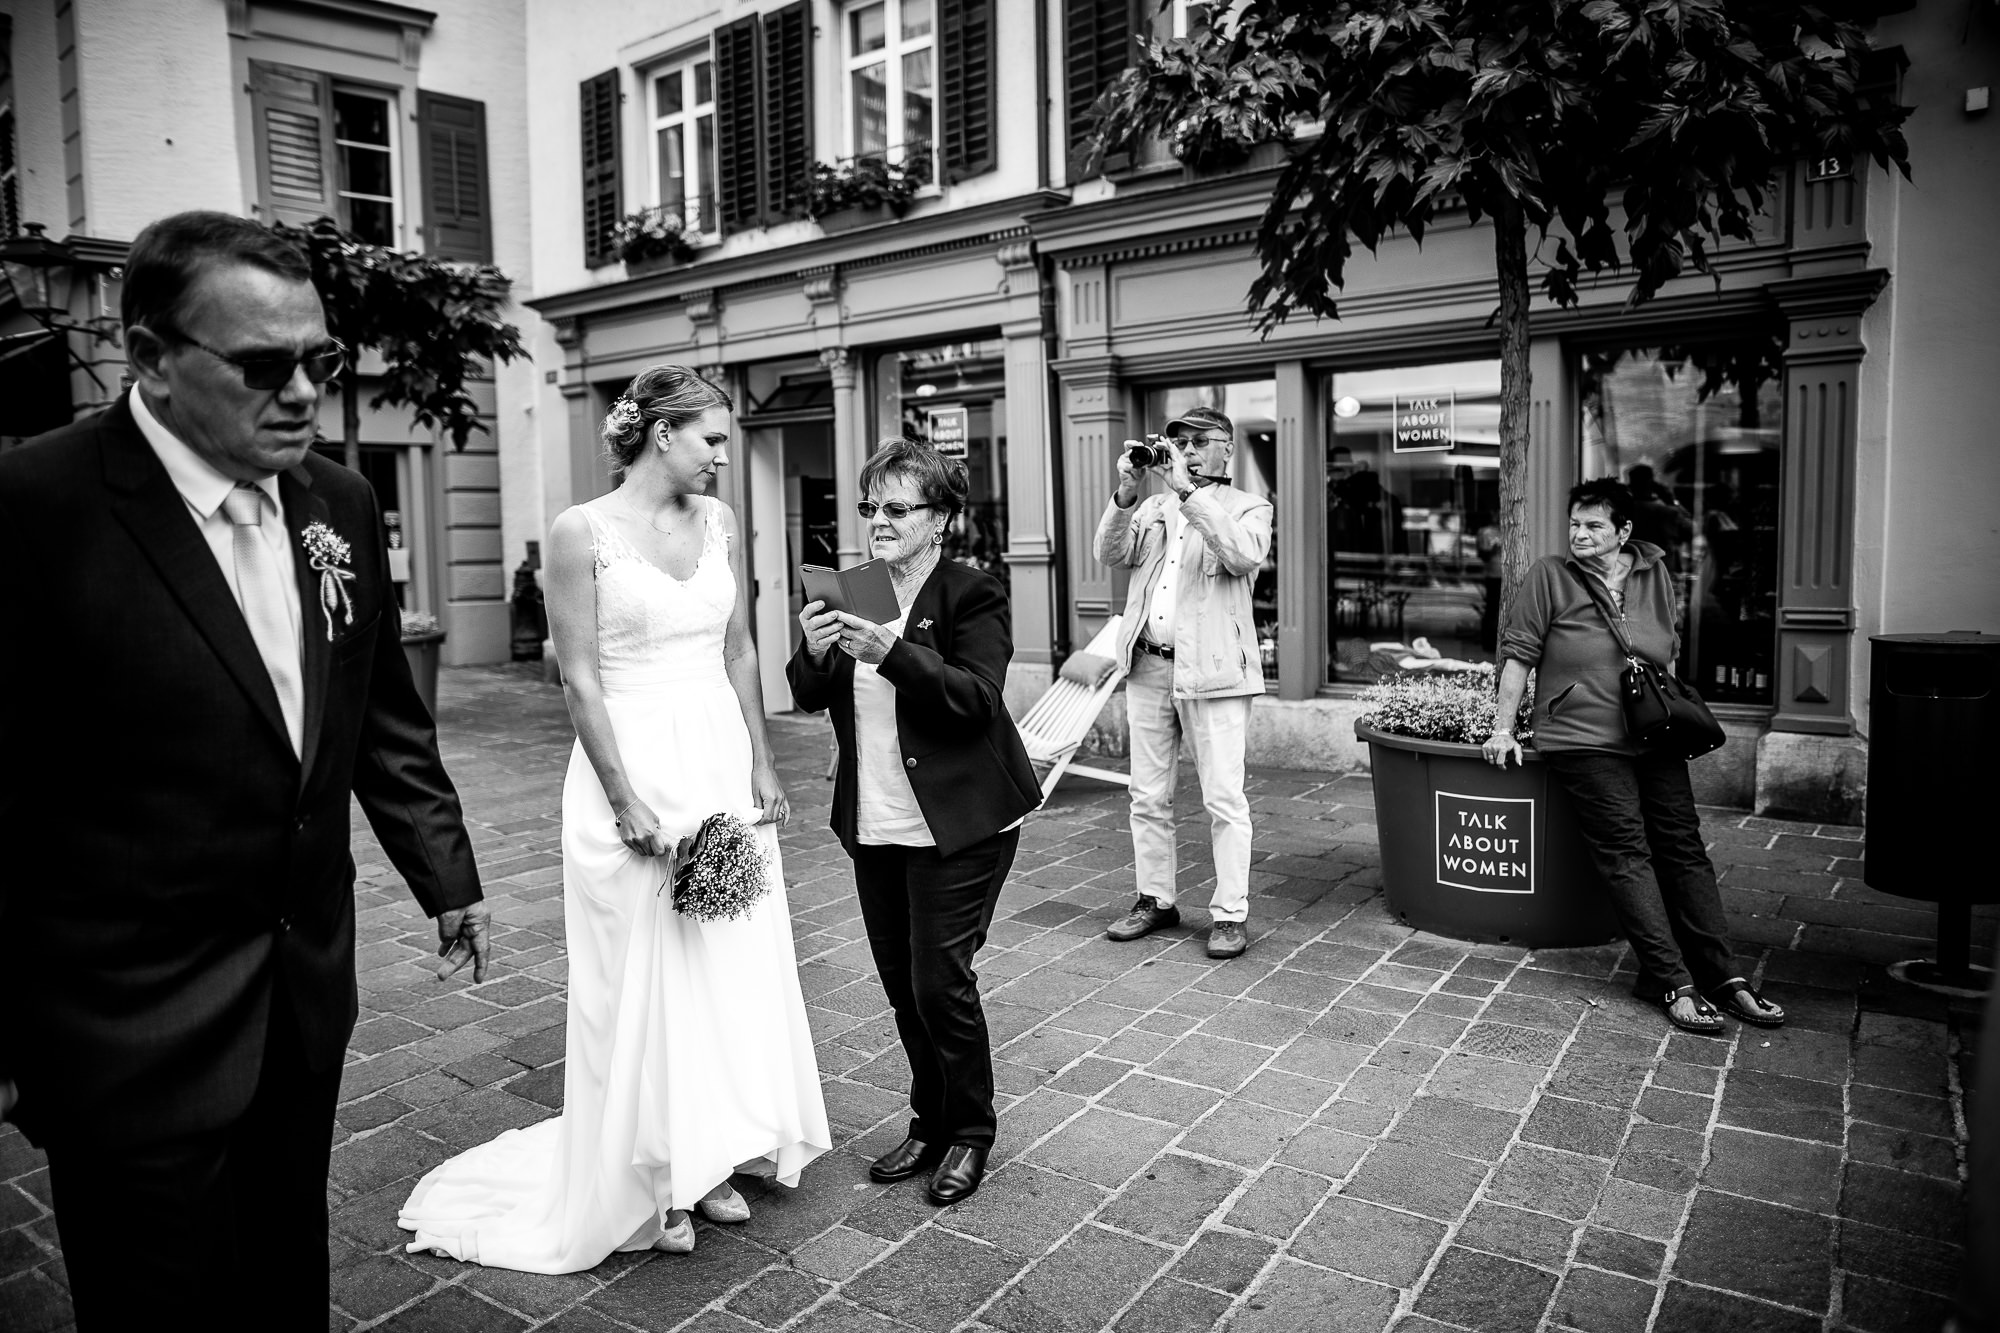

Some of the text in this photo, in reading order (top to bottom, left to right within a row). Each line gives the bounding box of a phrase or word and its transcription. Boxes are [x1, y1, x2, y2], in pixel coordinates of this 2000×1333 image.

[1817, 156, 1840, 176] 13
[1409, 398, 1440, 411] TALK
[1401, 412, 1446, 427] ABOUT
[1398, 427, 1450, 442] WOMEN
[1458, 810, 1507, 830] TALK
[1448, 832, 1520, 854] ABOUT
[1443, 853, 1526, 878] WOMEN
